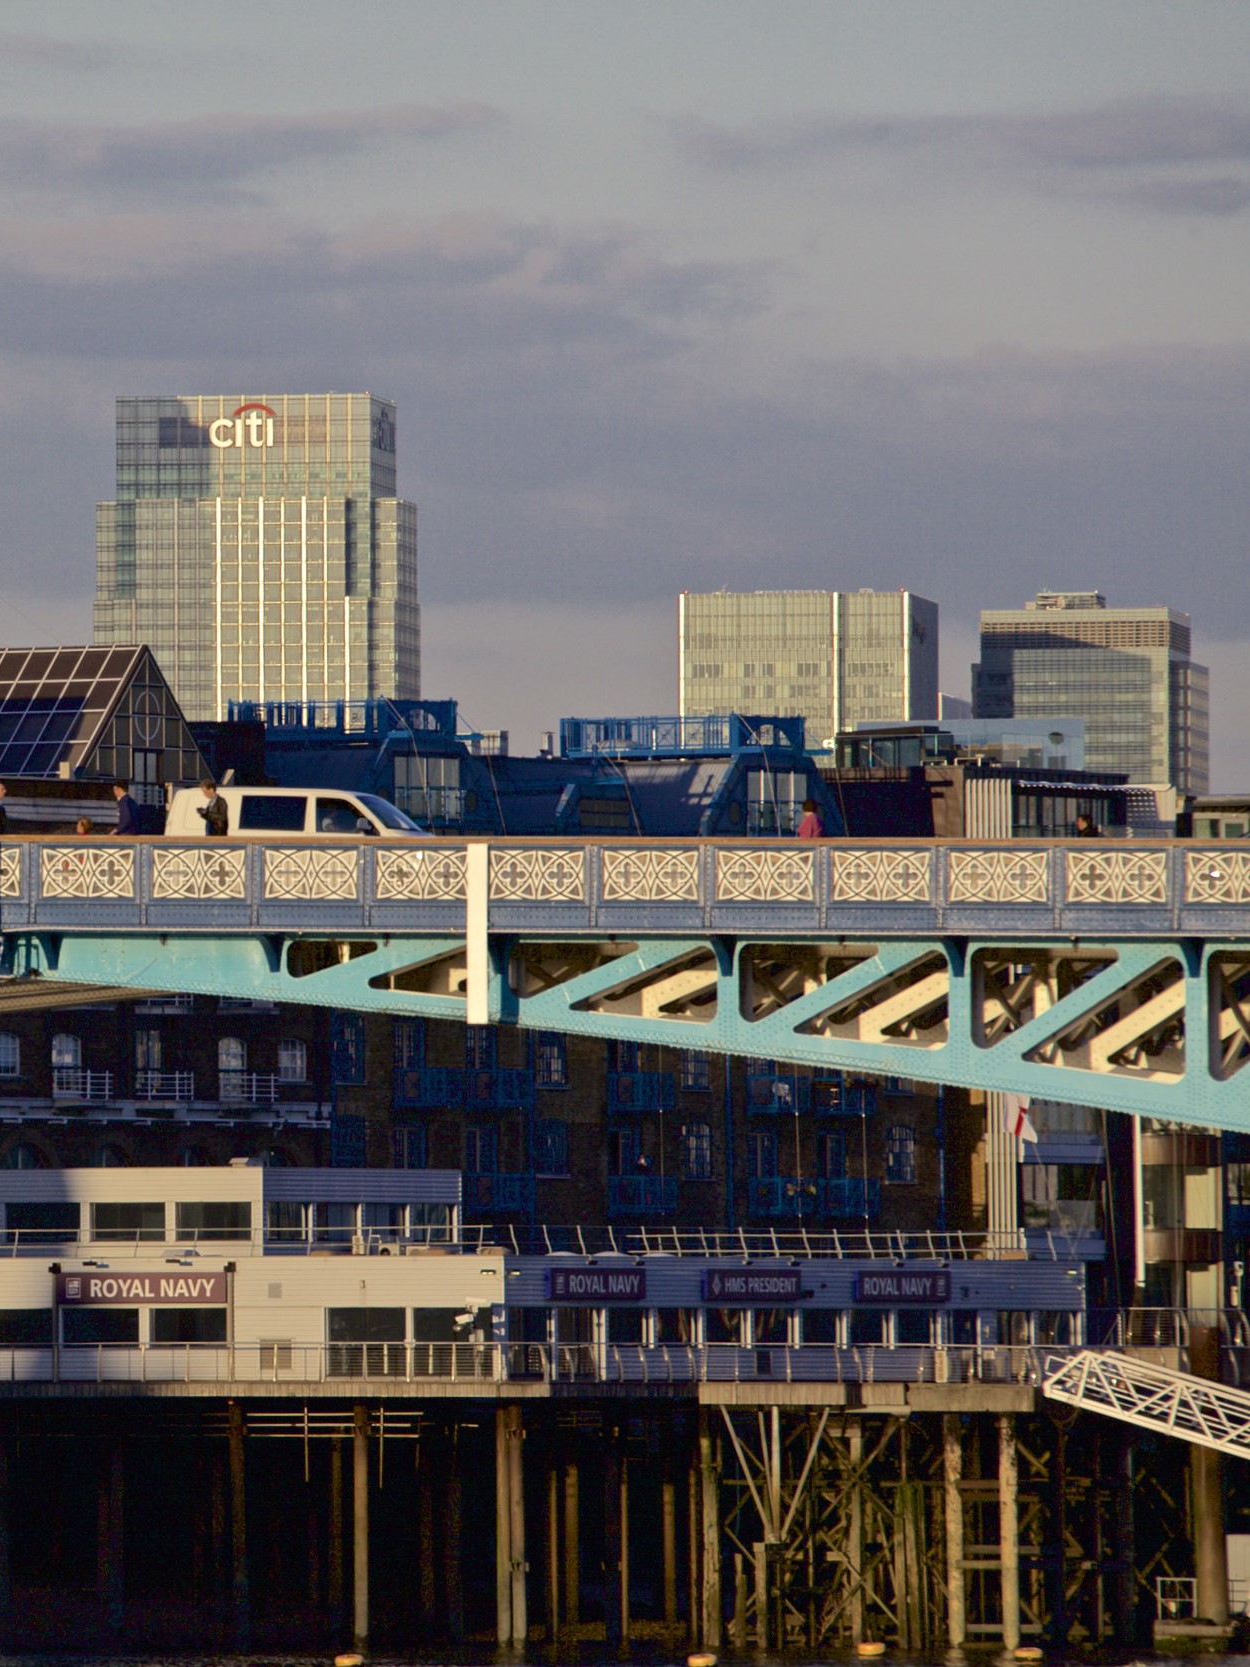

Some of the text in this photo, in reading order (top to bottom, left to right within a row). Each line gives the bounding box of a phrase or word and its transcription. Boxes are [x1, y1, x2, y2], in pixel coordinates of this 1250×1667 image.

[209, 410, 274, 448] citi
[90, 1279, 155, 1298] ROYAL
[160, 1279, 216, 1298] NAVY
[569, 1274, 640, 1293] ROYAL NAVY
[724, 1277, 798, 1293] HMS PRESIDENT
[863, 1277, 933, 1296] ROYAL NAVY
